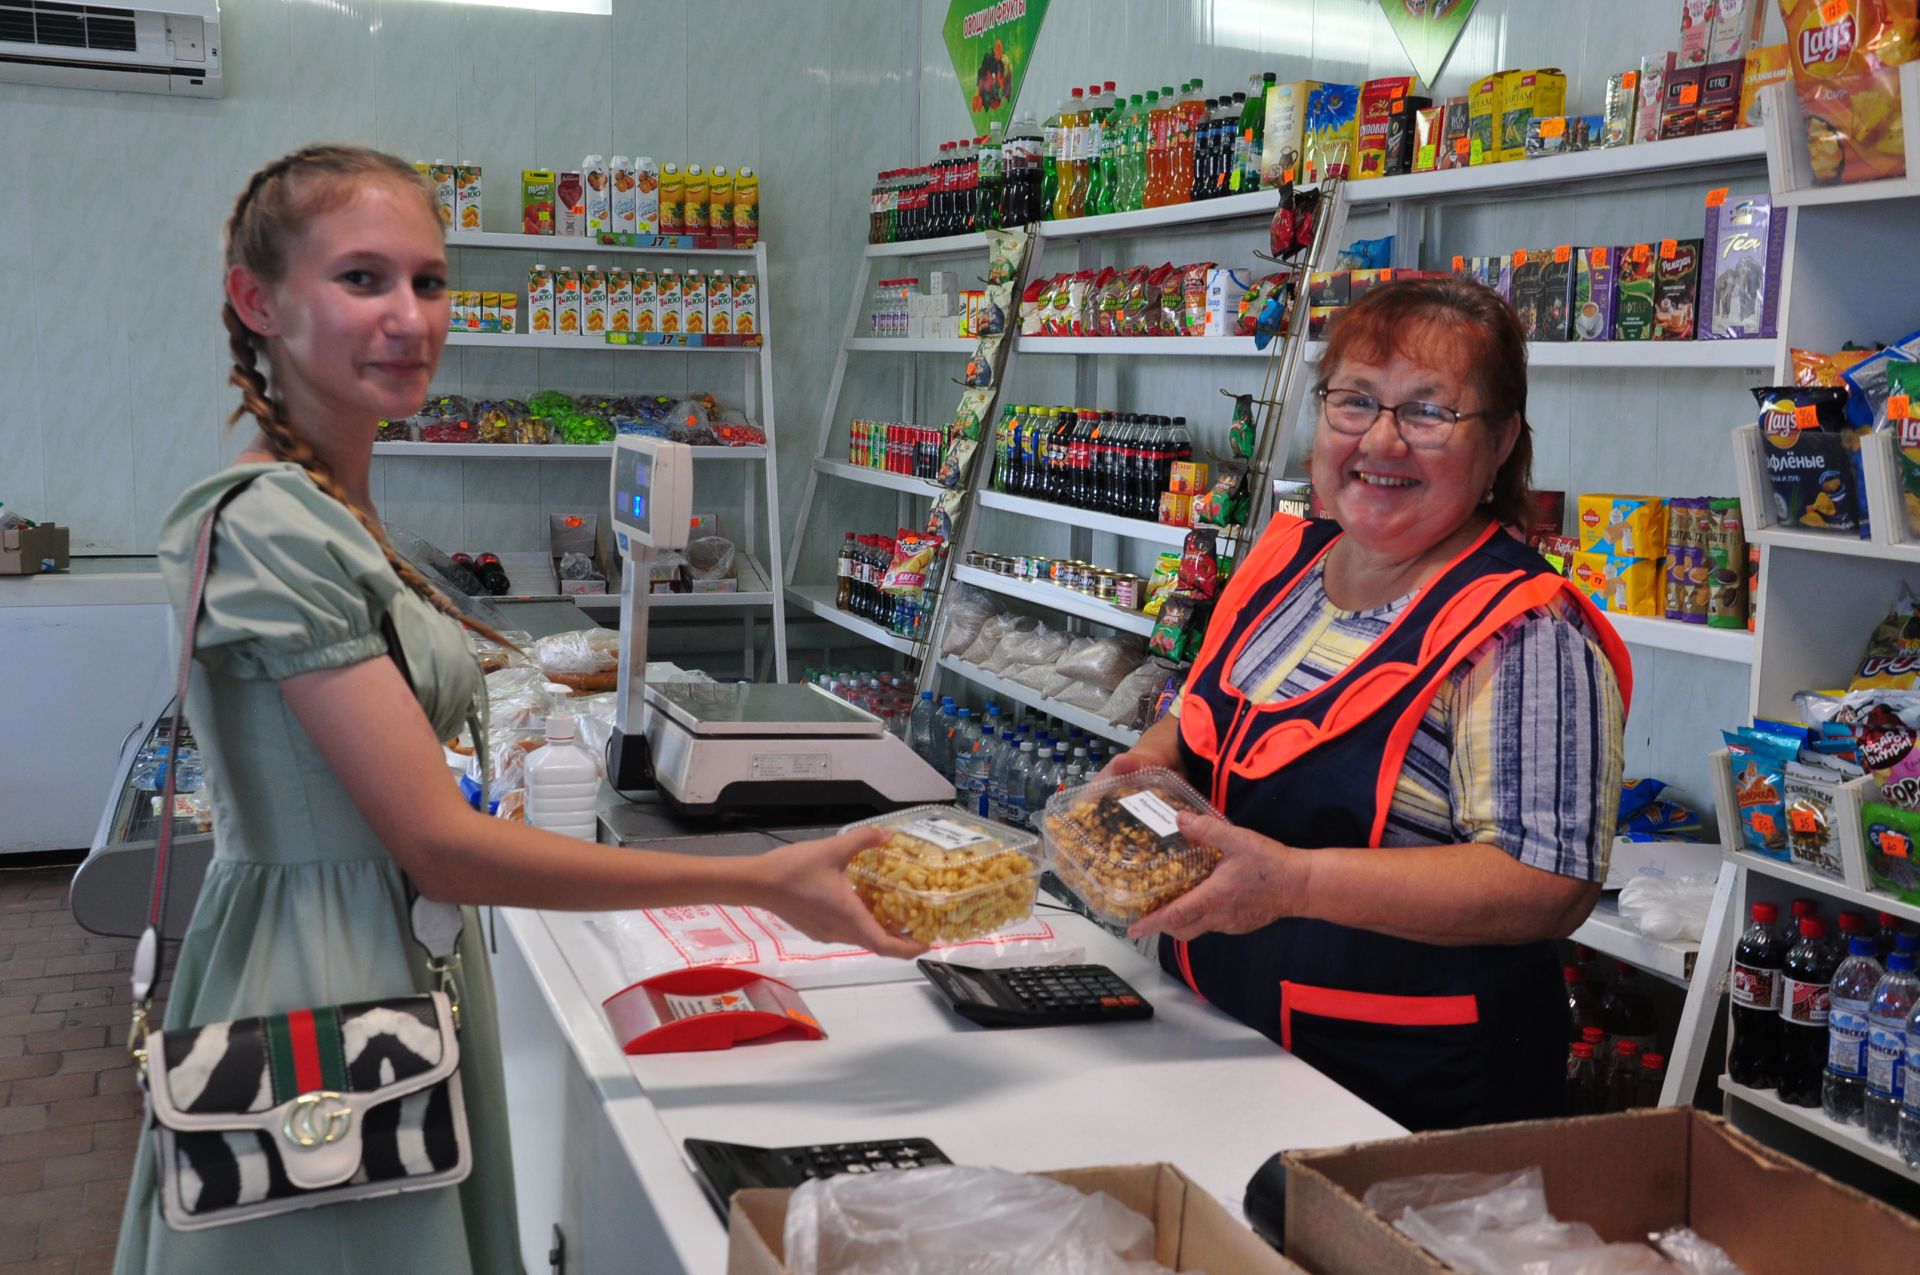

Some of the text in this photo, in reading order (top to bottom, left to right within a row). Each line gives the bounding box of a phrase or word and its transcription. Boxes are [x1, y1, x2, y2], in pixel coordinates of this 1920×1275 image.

[963, 0, 1026, 39] ОВОЩИ И ФРУКТЫ
[1709, 77, 1728, 89] ETRE
[651, 236, 665, 247] J7
[1720, 232, 1761, 259] Tea
[659, 334, 674, 345] J7
[1767, 451, 1825, 472] флёные
[1860, 726, 1908, 757] ПОДАРОК
[1867, 737, 1912, 764] ВНУТРИ!
